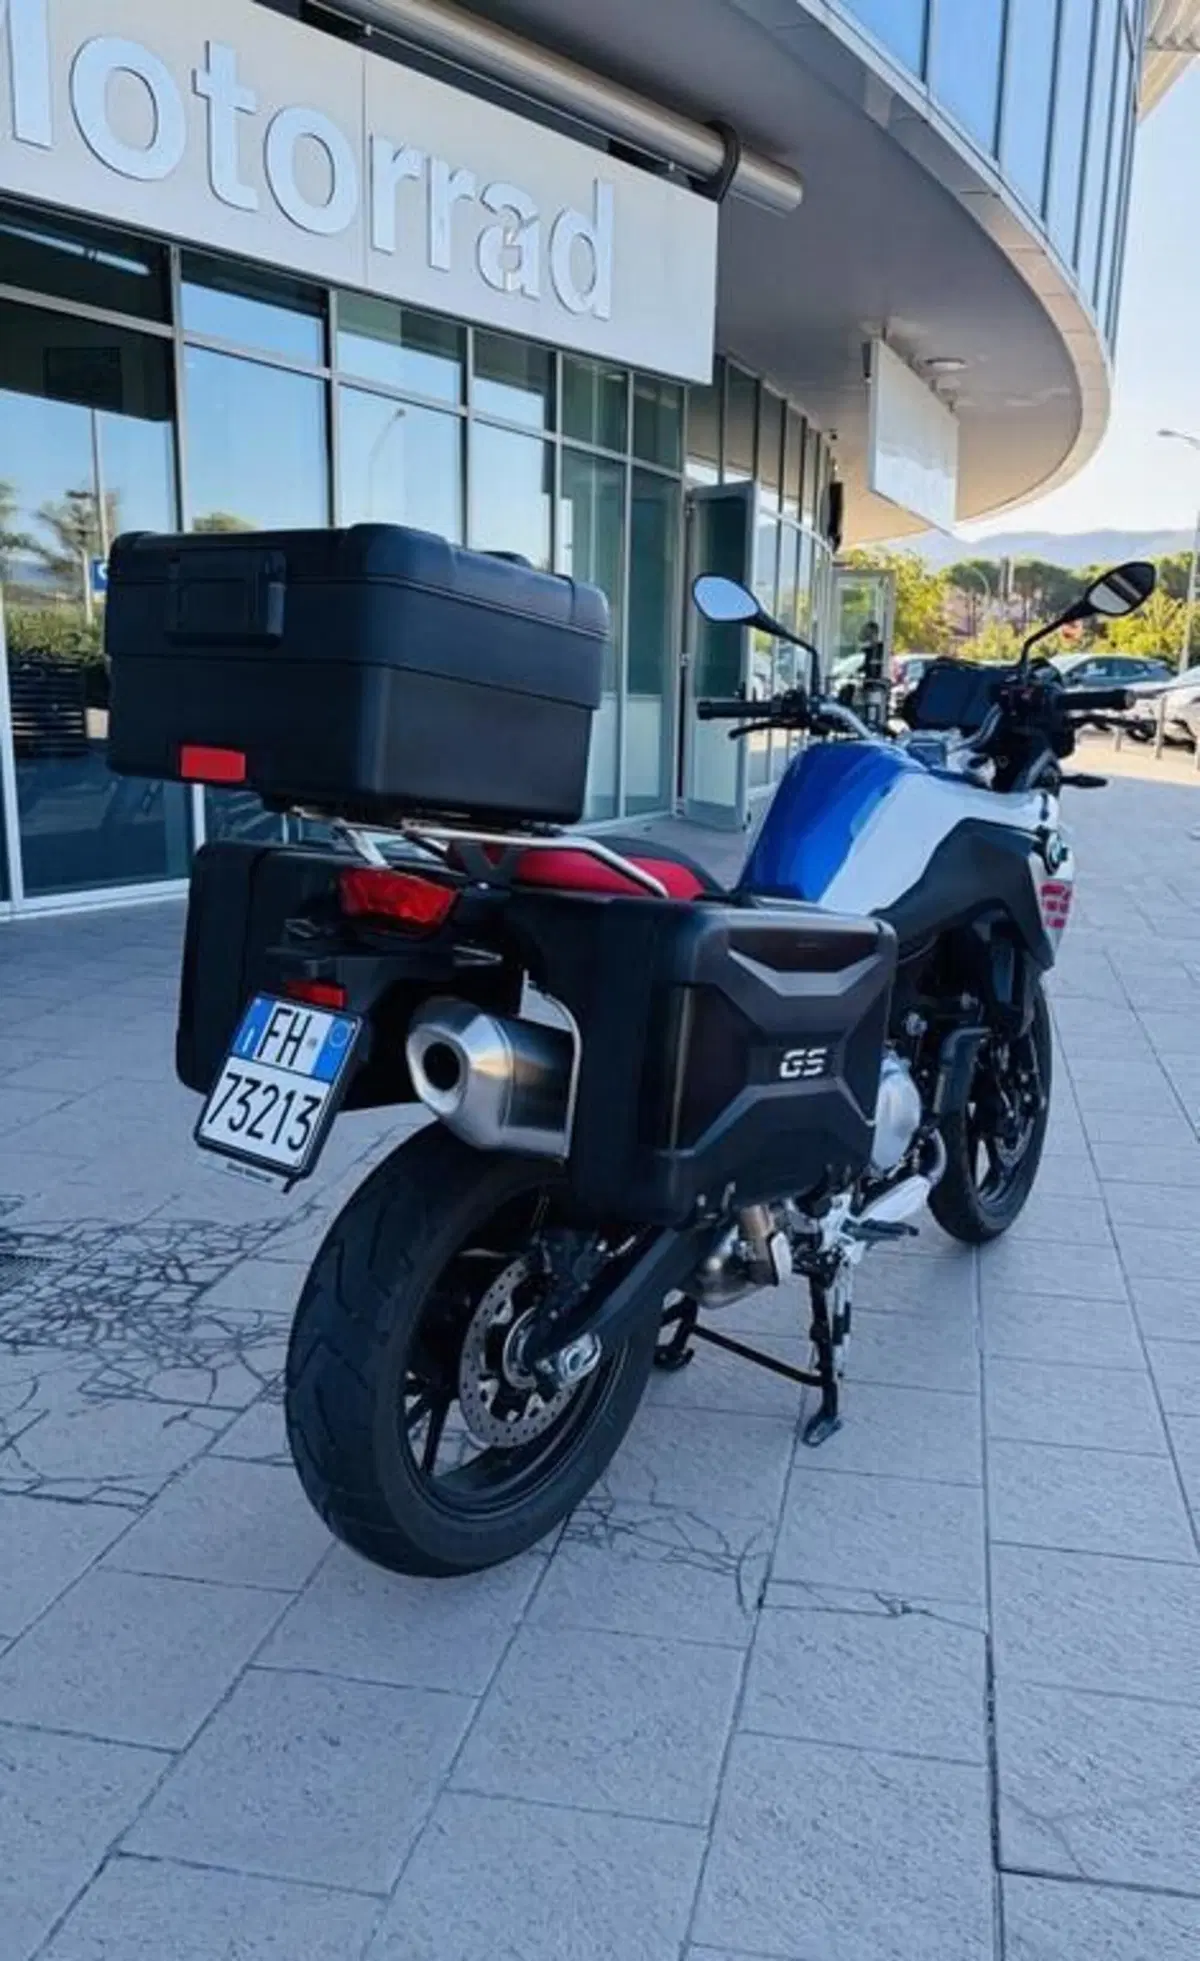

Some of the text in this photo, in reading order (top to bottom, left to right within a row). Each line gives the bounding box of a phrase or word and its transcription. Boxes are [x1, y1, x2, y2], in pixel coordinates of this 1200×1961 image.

[257, 1008, 312, 1067] FH
[779, 1047, 828, 1079] GS
[208, 1071, 322, 1152] 73213
